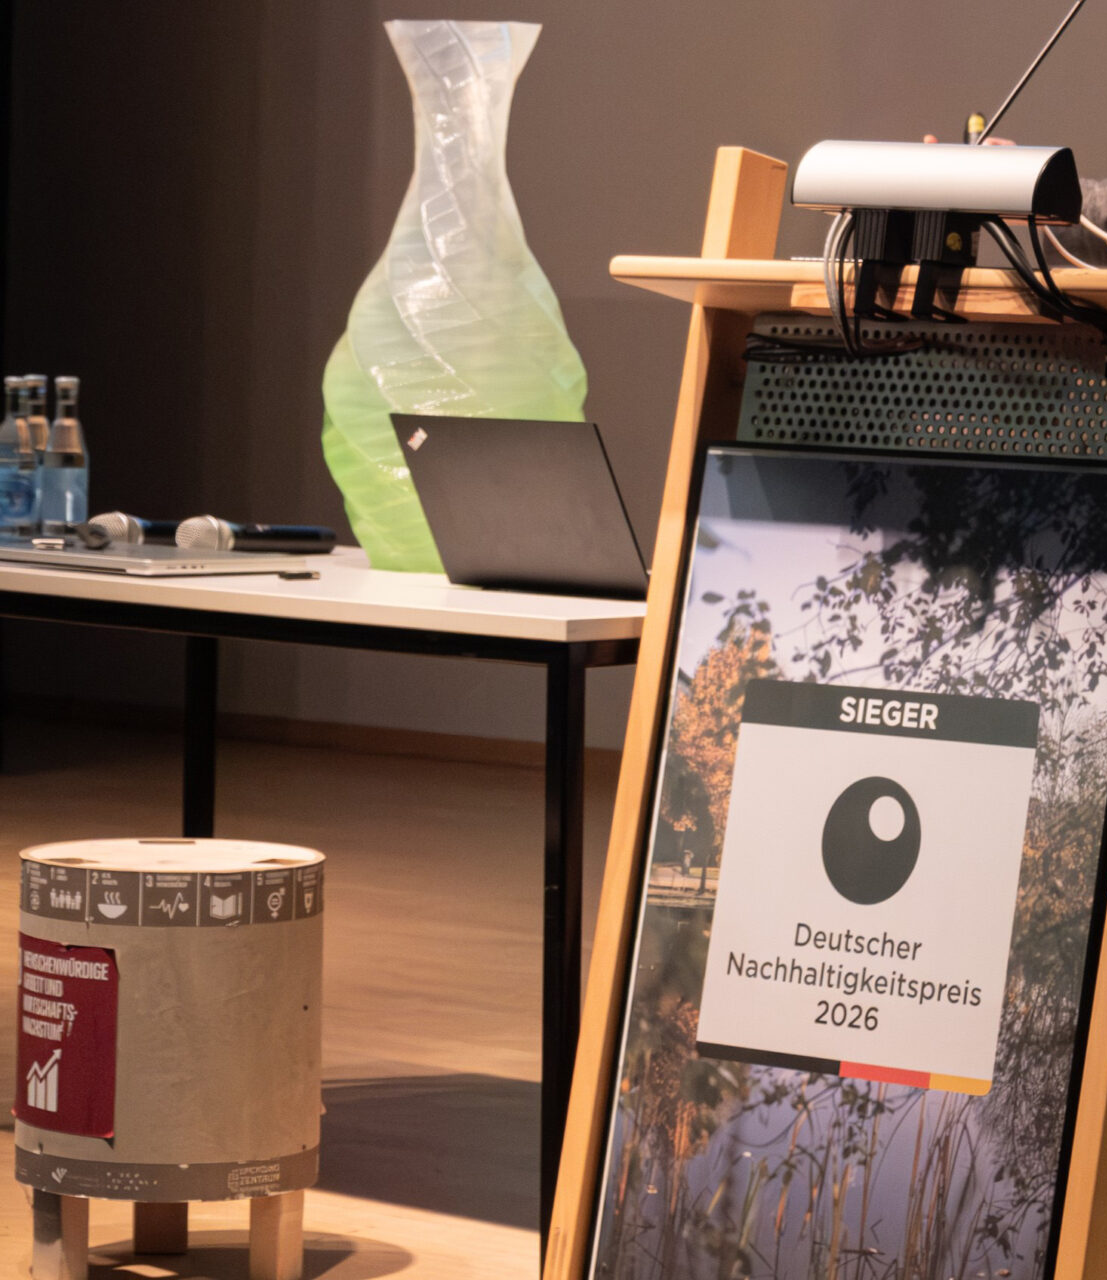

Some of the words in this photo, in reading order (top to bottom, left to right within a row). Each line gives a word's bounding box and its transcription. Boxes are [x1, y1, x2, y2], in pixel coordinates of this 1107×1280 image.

[839, 695, 939, 731] SIEGER
[793, 922, 923, 962] Deutscher
[726, 951, 982, 1007] Nachhaltigkeitspreis
[814, 999, 879, 1032] 2026
